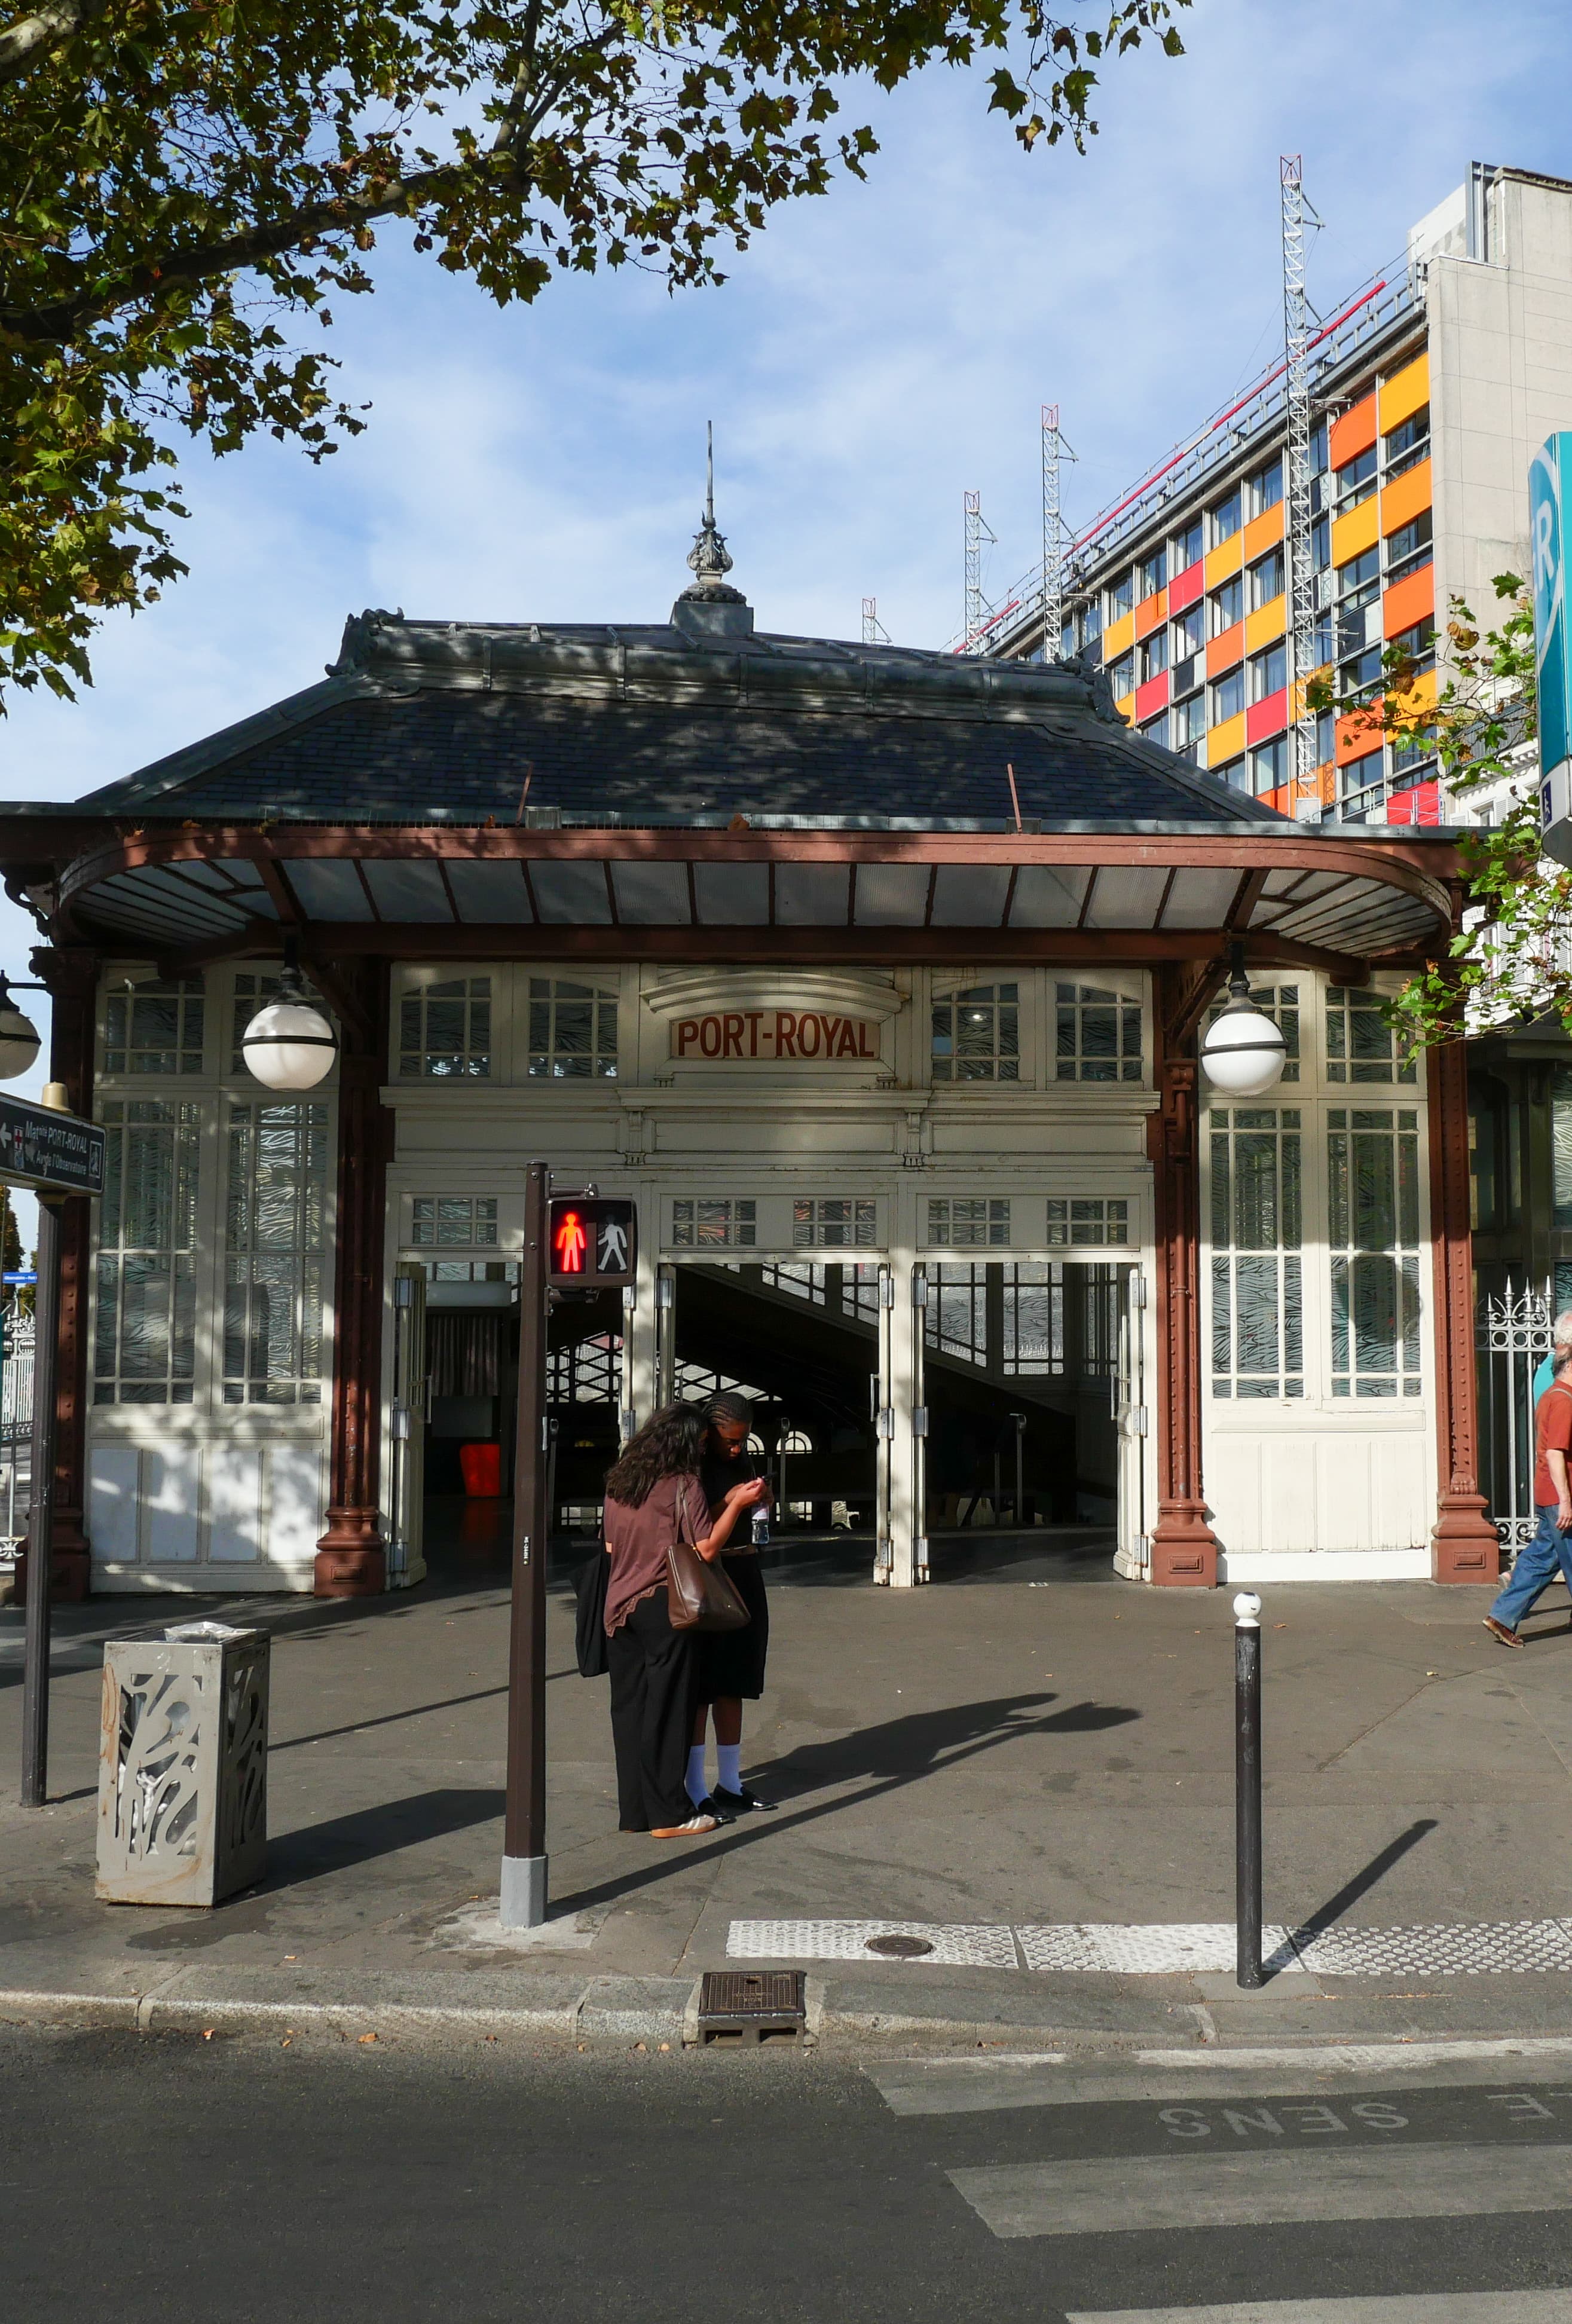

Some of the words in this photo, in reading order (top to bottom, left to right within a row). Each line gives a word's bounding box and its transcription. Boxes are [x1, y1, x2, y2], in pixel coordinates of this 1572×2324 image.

[678, 1012, 874, 1057] PORT-ROYAL
[48, 1127, 87, 1154] PORT-ROYAL
[1158, 2102, 1409, 2138] SENS
